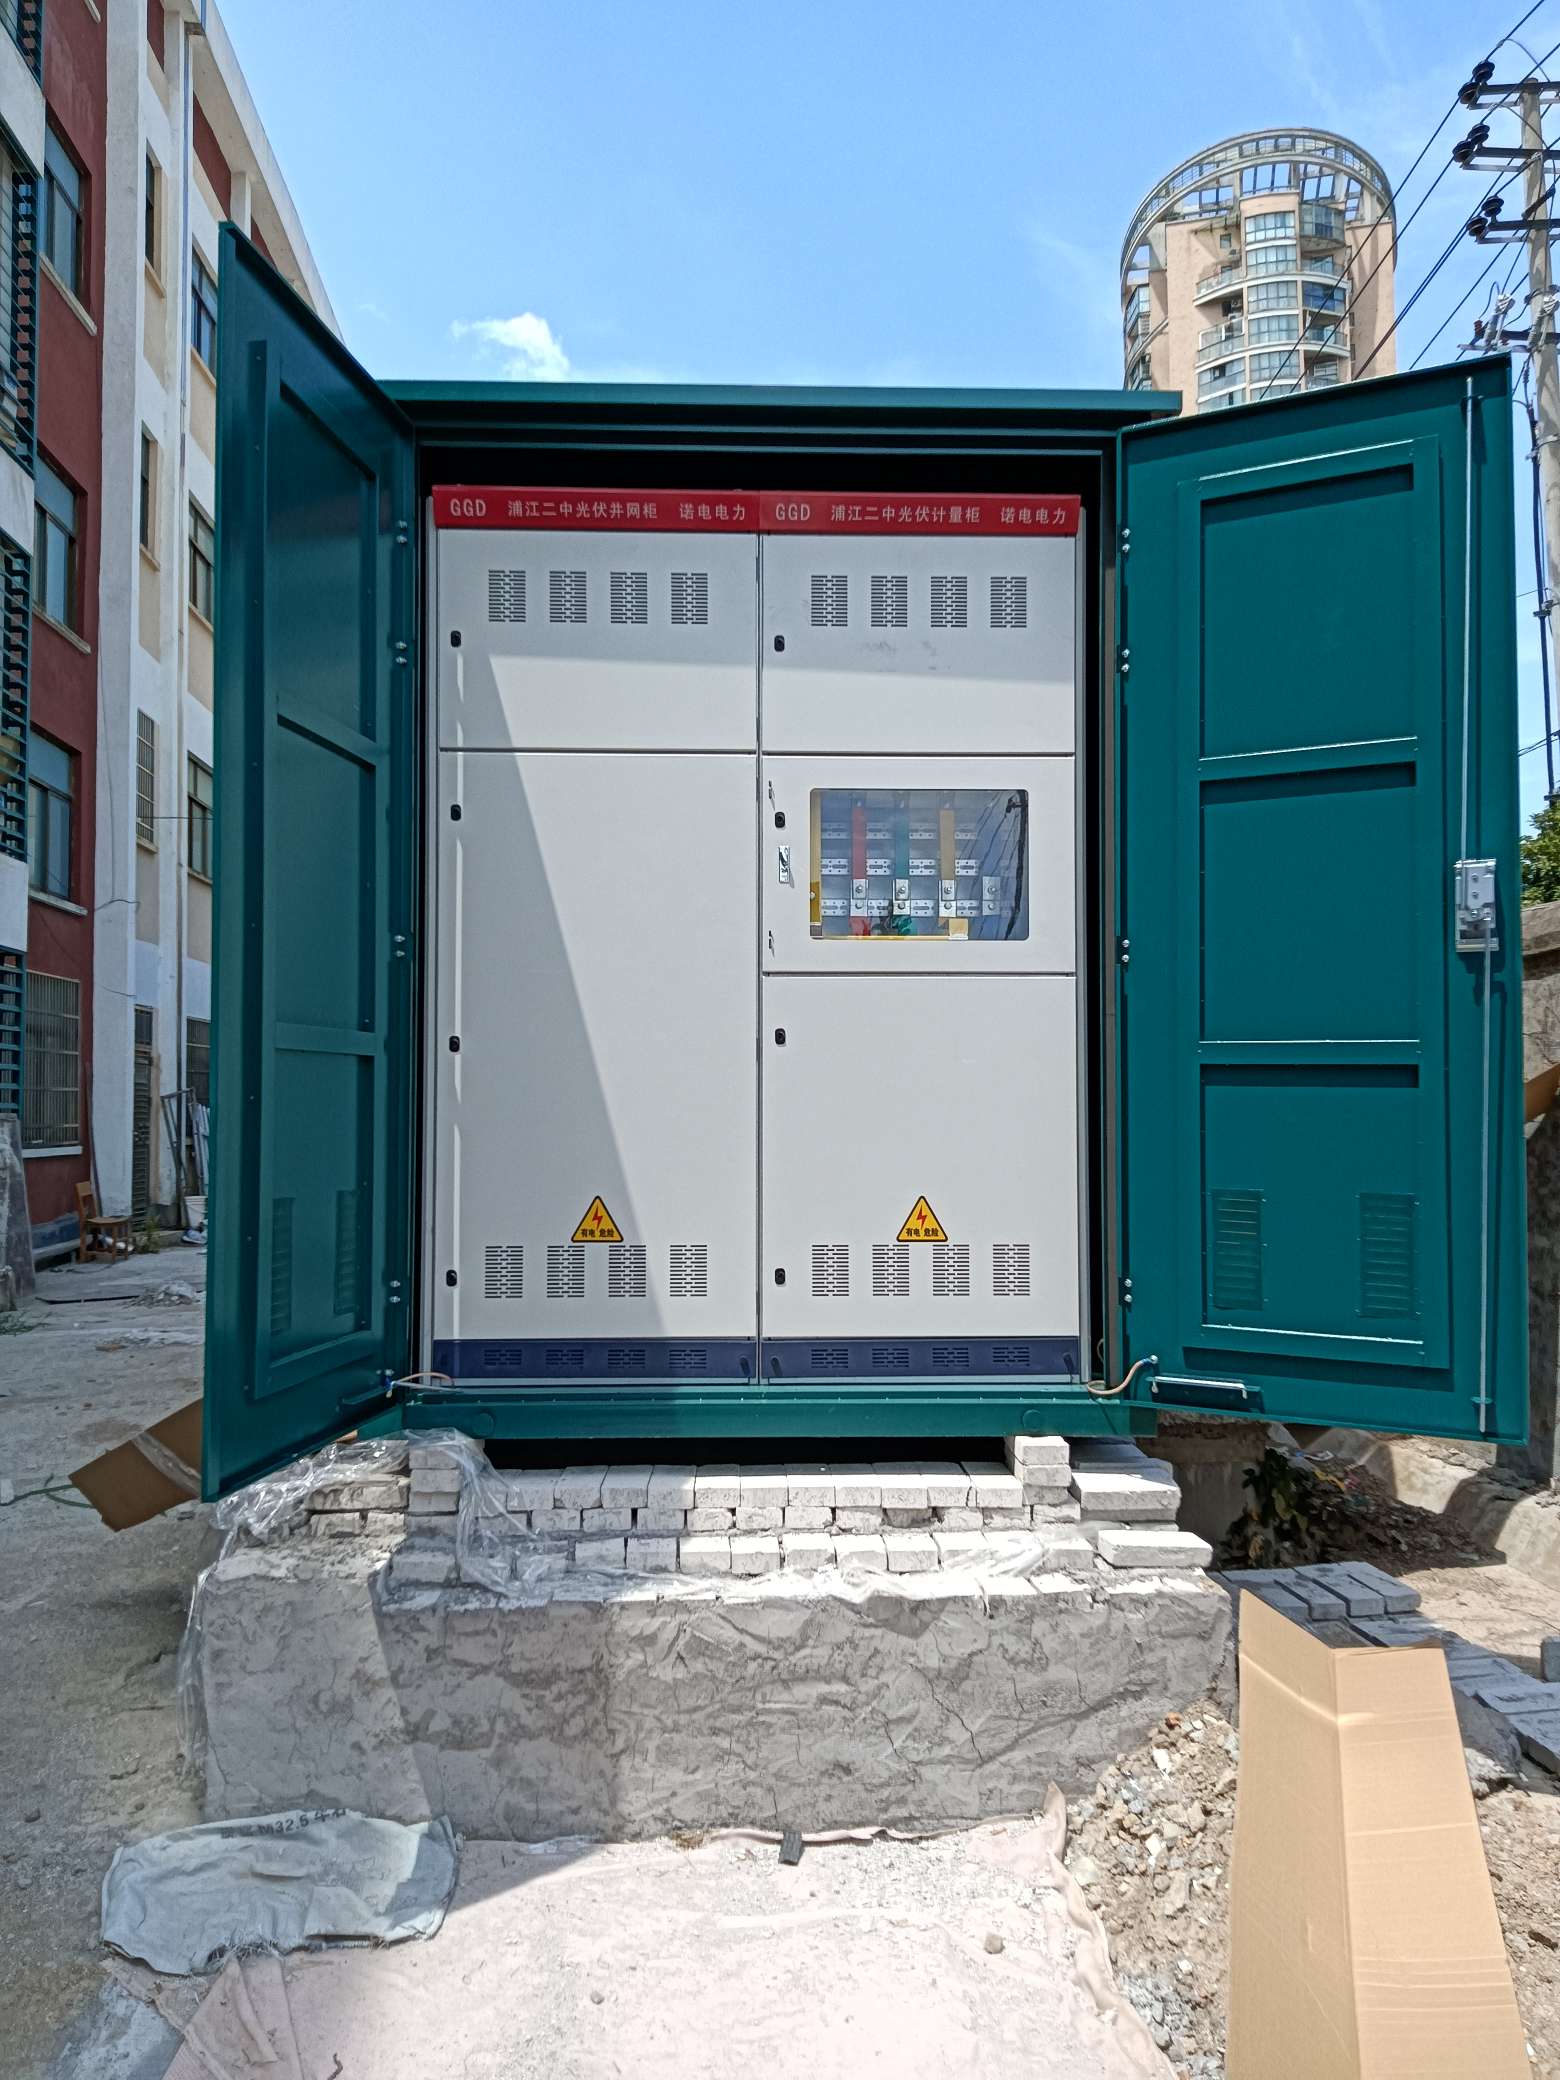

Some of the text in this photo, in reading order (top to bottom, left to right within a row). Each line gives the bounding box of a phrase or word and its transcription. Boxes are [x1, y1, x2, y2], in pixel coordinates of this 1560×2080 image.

[449, 498, 746, 521] GGD 浦江二中光伏并网柜 诺电电力
[775, 503, 1067, 525] GGD 浦江二中光伏计量柜 诺电电力
